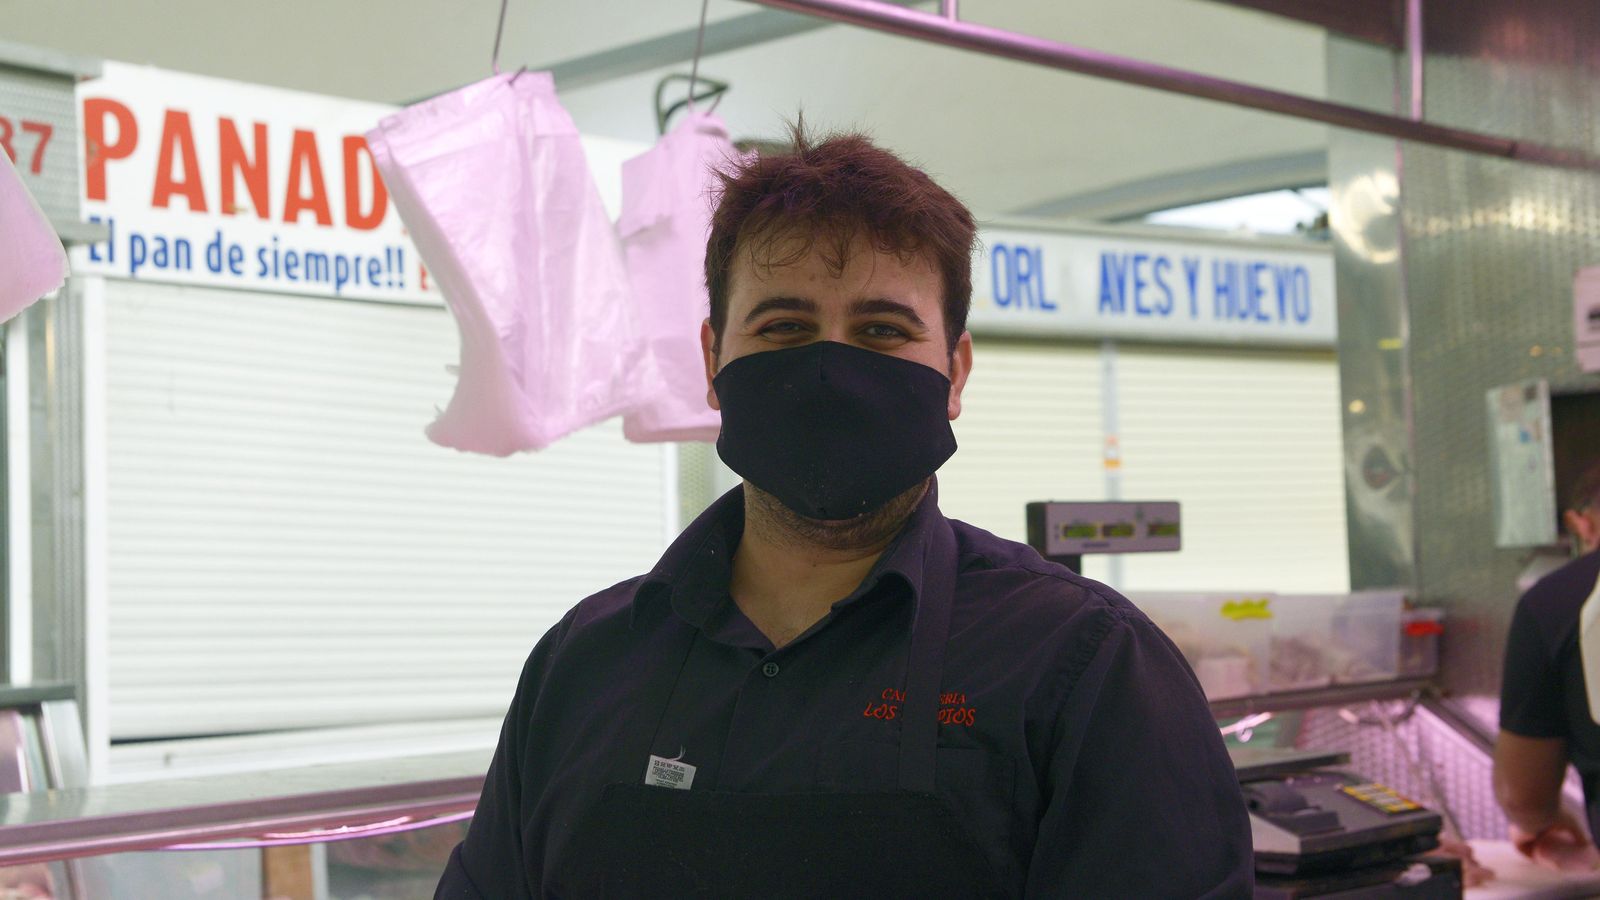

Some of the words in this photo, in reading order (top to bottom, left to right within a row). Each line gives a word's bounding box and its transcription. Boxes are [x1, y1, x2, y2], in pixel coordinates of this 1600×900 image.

[127, 230, 194, 276] pan
[204, 229, 246, 278] de
[255, 235, 405, 297] siempre!!
[989, 241, 1058, 313] ORL
[1097, 251, 1175, 318] AVES
[1181, 255, 1201, 320] Y
[1210, 259, 1312, 326] HUEVO
[863, 702, 898, 721] LOS
